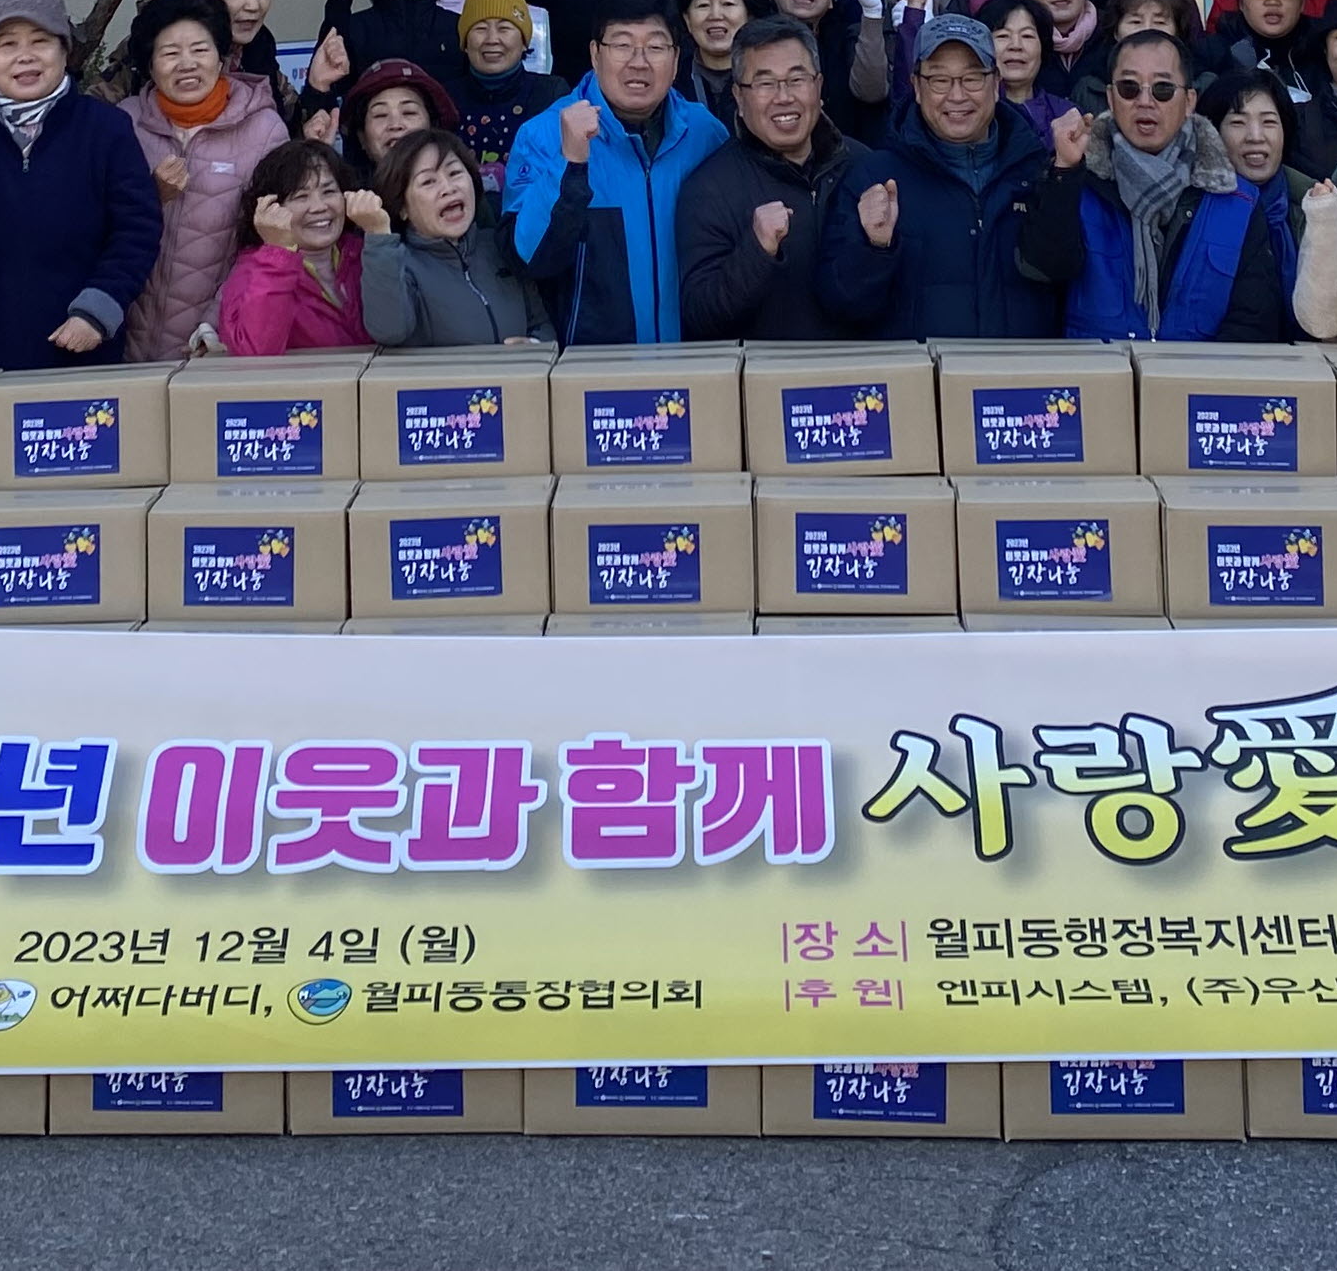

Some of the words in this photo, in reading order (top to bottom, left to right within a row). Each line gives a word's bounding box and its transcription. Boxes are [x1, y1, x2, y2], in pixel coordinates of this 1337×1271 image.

[409, 428, 475, 450] 김장나눔
[596, 429, 663, 451] 김장나눔
[795, 425, 862, 448] 김장나눔
[986, 427, 1054, 449] 김장나눔
[1198, 435, 1268, 455] 김장나눔
[24, 440, 91, 462] 김장나눔
[227, 440, 295, 462] 김장나눔
[402, 560, 472, 583] 김장나눔
[600, 566, 671, 589] 김장나눔
[806, 556, 878, 578] 김장나눔
[1009, 562, 1080, 585] 김장나눔
[0, 568, 71, 592] 김장나눔
[194, 569, 265, 591] 김장나눔
[1220, 568, 1293, 590] 김장나눔
[141, 741, 543, 871] 이웃과
[564, 735, 831, 866] 함께
[14, 928, 170, 965] 2023년
[195, 927, 290, 965] 12월
[308, 926, 379, 963] 4일
[399, 924, 477, 965] (월)
[49, 983, 273, 1018] 어쩌다버디,
[361, 979, 703, 1013] 월피동통장협의회
[936, 977, 1168, 1007] 엔피시스템,
[345, 1072, 428, 1099] 김장나눔
[826, 1076, 911, 1103] 김장나눔
[1062, 1069, 1148, 1096] 김장나눔
